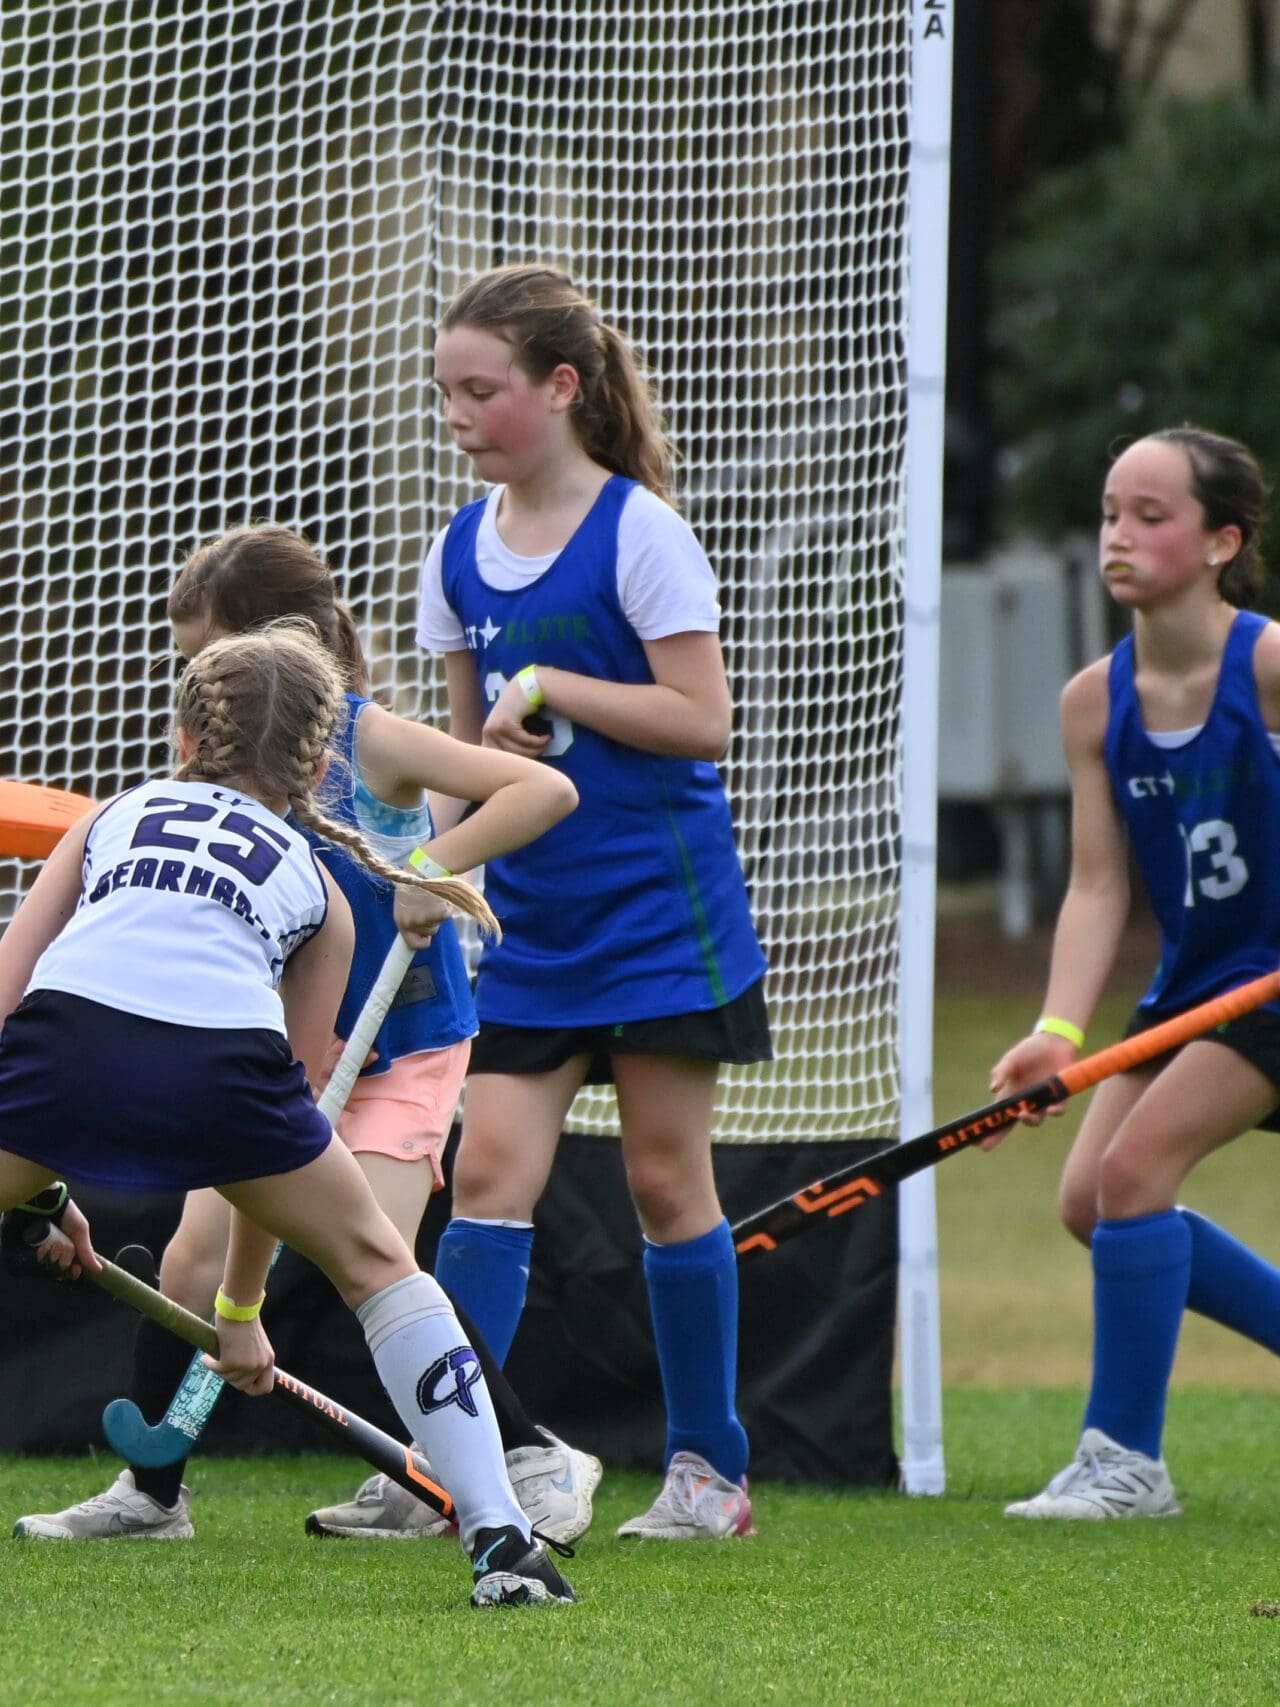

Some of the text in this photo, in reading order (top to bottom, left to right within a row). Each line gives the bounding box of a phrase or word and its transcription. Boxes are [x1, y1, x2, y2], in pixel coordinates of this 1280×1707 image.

[129, 796, 292, 887] 25
[1178, 819, 1249, 908] 13
[937, 1099, 1038, 1151] RITUAL
[278, 1374, 350, 1427] RITUAL
